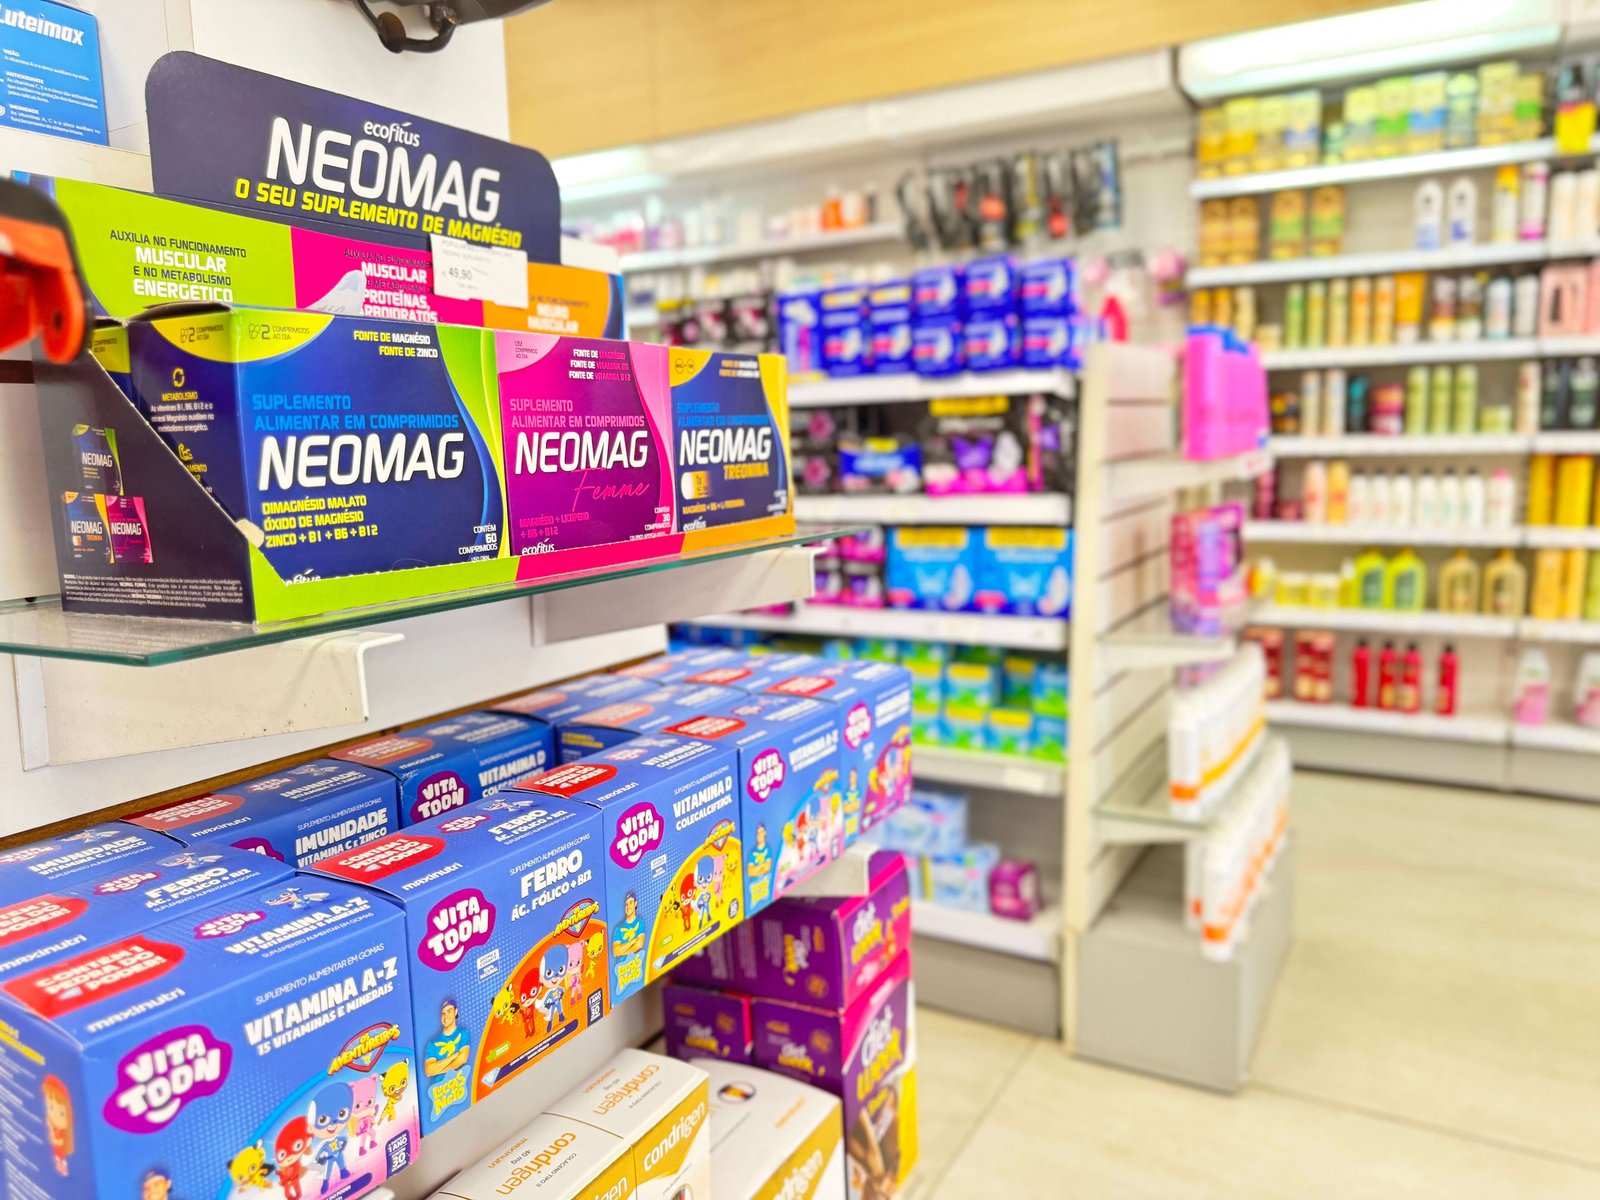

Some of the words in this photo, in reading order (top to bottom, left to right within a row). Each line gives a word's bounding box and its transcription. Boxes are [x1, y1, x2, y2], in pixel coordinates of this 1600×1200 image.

[0, 3, 84, 46] uteimax
[266, 117, 500, 222] NEOMAG
[234, 178, 250, 198] O
[256, 183, 297, 207] SEU
[301, 194, 417, 230] SUPLEMENTO
[422, 215, 443, 234] DE
[447, 221, 522, 249] MAGNÉSIO
[109, 229, 151, 244] AUXILIA
[153, 236, 167, 246] NO
[169, 238, 247, 258] FUNCIONAMENTO
[344, 248, 373, 260] AUXILIA
[135, 246, 227, 273] MUSCULAR
[361, 261, 427, 284] MUSCULAR
[133, 266, 140, 275] E
[143, 267, 158, 277] NO
[161, 268, 232, 286] METABOLISMO
[133, 278, 233, 302] ENERGÉTICO
[189, 327, 196, 343] 2
[261, 324, 271, 340] 2
[273, 325, 310, 334] COMPRIMIDOS
[353, 330, 379, 343] FONTE
[380, 332, 391, 343] DE
[392, 331, 431, 345] MAGNÉSIO
[379, 346, 404, 357] FONTE
[405, 347, 416, 357] DE
[416, 348, 439, 359] ZINCO
[570, 359, 587, 369] FONTE
[587, 360, 596, 369] DE
[573, 348, 589, 358] FONTE
[589, 349, 599, 359] DE
[569, 370, 586, 380] FONTE
[585, 371, 594, 380] DE
[162, 392, 198, 401] METABOLISMO
[252, 394, 352, 411] SUPLEMENTO
[510, 398, 573, 412] SUPLEMENTO
[254, 415, 341, 432] ALIMENTAR
[345, 415, 366, 430] EM
[369, 414, 460, 430] COMPRIMIDOS
[512, 415, 566, 428] ALIMENTAR
[569, 415, 583, 427] EM
[585, 415, 645, 428] COMPRIMIDOS
[82, 452, 113, 468] NEOMAG
[258, 432, 465, 491] NEOMAG
[515, 430, 648, 475] NEOMAG
[679, 427, 772, 466] NEOMAG
[570, 466, 650, 512] Femme
[261, 496, 326, 515] DIMAGNÉSIO
[327, 495, 367, 511] MALATO
[71, 520, 102, 534] NEOMAG
[111, 522, 141, 535] NEOMAG
[264, 515, 297, 531] ÓXIDO
[299, 514, 314, 527] DE
[315, 510, 364, 526] MAGNÉSIO
[473, 523, 497, 535] CONTÉM
[519, 514, 554, 528] MAGNÉSIO
[265, 531, 297, 548] ZINCO
[334, 526, 348, 539] B6
[358, 525, 378, 538] B12
[458, 543, 498, 555] COMPRIMIDOS
[485, 533, 497, 544] 60
[478, 755, 536, 787] VITAMINA
[750, 762, 783, 793] TOON
[753, 752, 779, 775] VITA
[280, 770, 361, 798] IMUNIDADE
[422, 776, 458, 801] VITA
[672, 779, 725, 819] VITAMINA
[725, 775, 733, 792] D
[417, 787, 465, 818] TOON
[675, 794, 733, 831] COLECALCIFEROL
[190, 816, 252, 838] maxinutri
[295, 807, 388, 856] IMUNIDADE
[488, 809, 548, 835] FERRO
[620, 808, 654, 836] VITA
[297, 844, 344, 868] VITAMINA
[345, 841, 352, 850] C
[360, 826, 388, 845] ZINCO
[616, 820, 660, 856] TOON
[28, 836, 143, 872] IMUNIDADE
[509, 855, 542, 876] SUPLEMENTO
[541, 843, 567, 860] ALIMENTAR
[144, 866, 229, 899] FERRO
[402, 862, 463, 892] maxinutri
[520, 849, 583, 899] FERRO
[511, 901, 530, 922] ÁC.
[531, 880, 570, 912] FÓLICO
[577, 869, 592, 887] B12
[224, 911, 326, 955] VITAMINA
[331, 896, 369, 914] A-Z
[432, 897, 481, 931] VITA
[427, 909, 489, 957] TOON
[261, 939, 306, 958] SUPLEMENTO
[43, 963, 121, 995] PEDRA
[118, 951, 155, 967] DO
[84, 955, 168, 990] PODER!
[255, 977, 307, 1006] SUPLEMENTO
[307, 959, 347, 984] ALIMENTAR
[346, 955, 358, 966] EM
[358, 943, 385, 961] GOMAS
[86, 987, 186, 1033] maxinutri
[243, 976, 359, 1046] VITAMINA
[362, 957, 398, 991] A-Z
[256, 1041, 271, 1056] 15
[271, 1009, 337, 1051] VITAMINAS
[337, 1007, 346, 1019] E
[346, 981, 394, 1011] MINERAIS
[328, 1024, 401, 1076] AVENTUREIROS
[861, 1005, 894, 1068] diet
[125, 1033, 206, 1084] VITA
[116, 1048, 221, 1118] TOON
[593, 1064, 661, 1116] condrigen
[393, 1137, 408, 1150] ANO
[643, 1101, 705, 1172] condrigen
[392, 1152, 406, 1168] 30
[487, 1137, 528, 1169] maxinutri
[495, 1131, 577, 1196] condrigen
